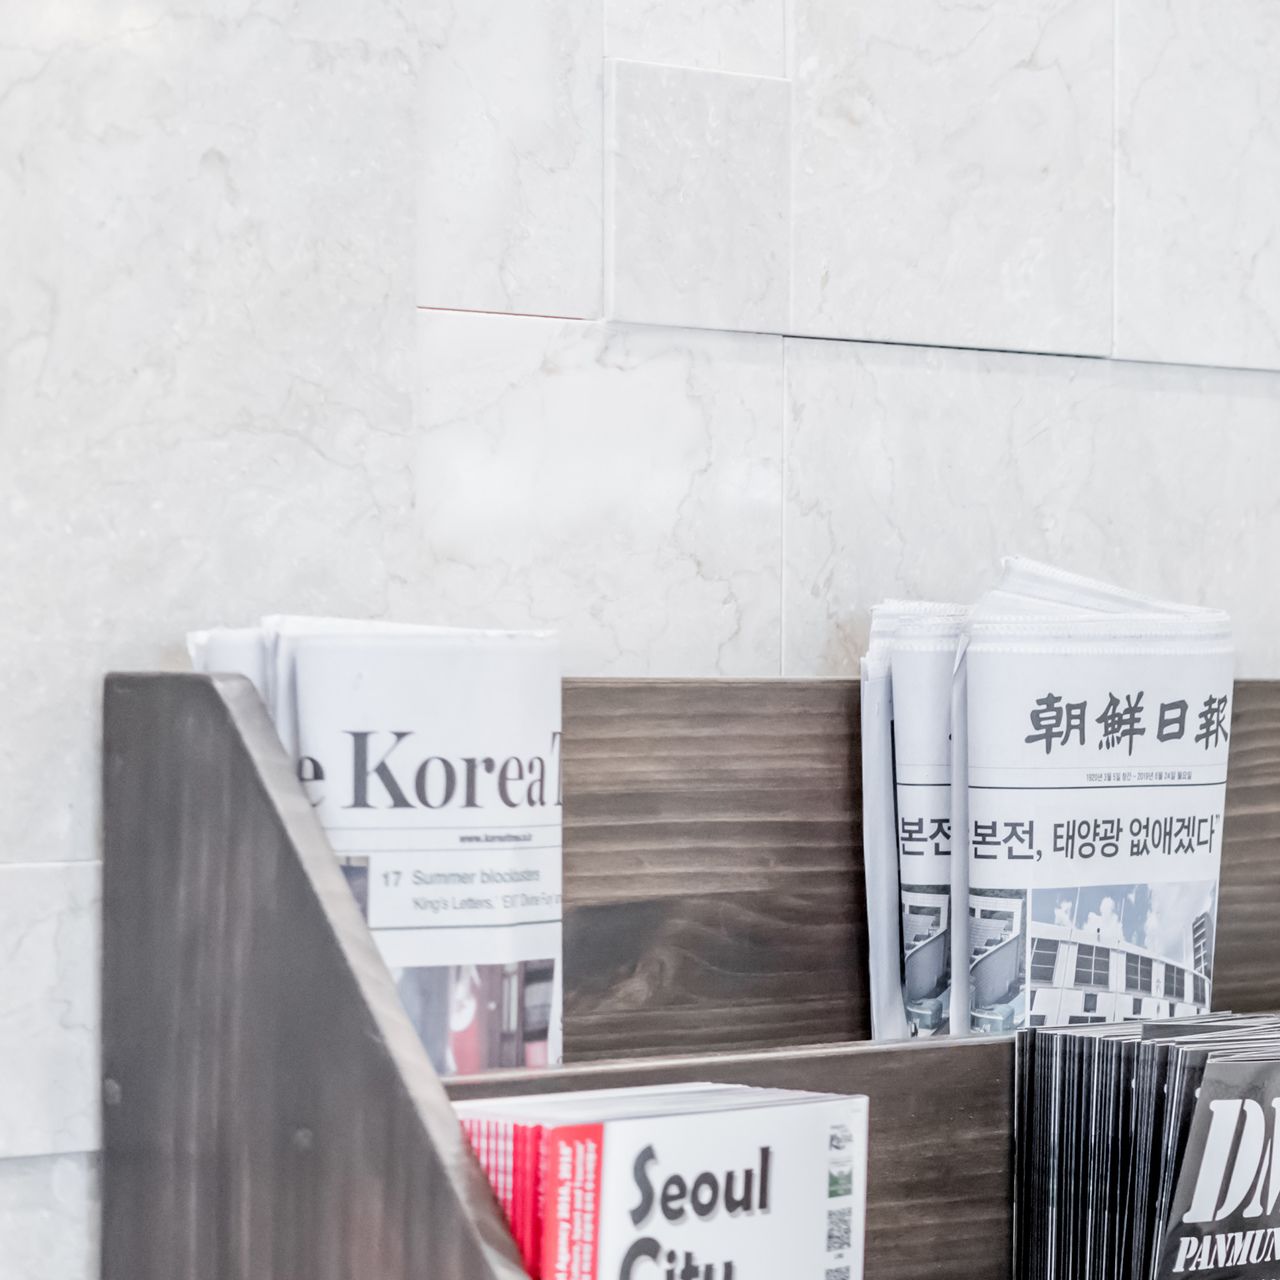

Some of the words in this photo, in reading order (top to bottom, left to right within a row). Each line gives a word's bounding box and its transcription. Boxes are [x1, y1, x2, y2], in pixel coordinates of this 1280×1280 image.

[1025, 690, 1228, 756] 朝鮮日報
[342, 731, 546, 809] Korea
[972, 819, 1042, 862] 본전,
[1053, 818, 1123, 859] 태양광
[382, 871, 402, 887] 17
[411, 871, 476, 885] Summer
[630, 1144, 771, 1227] Seoul
